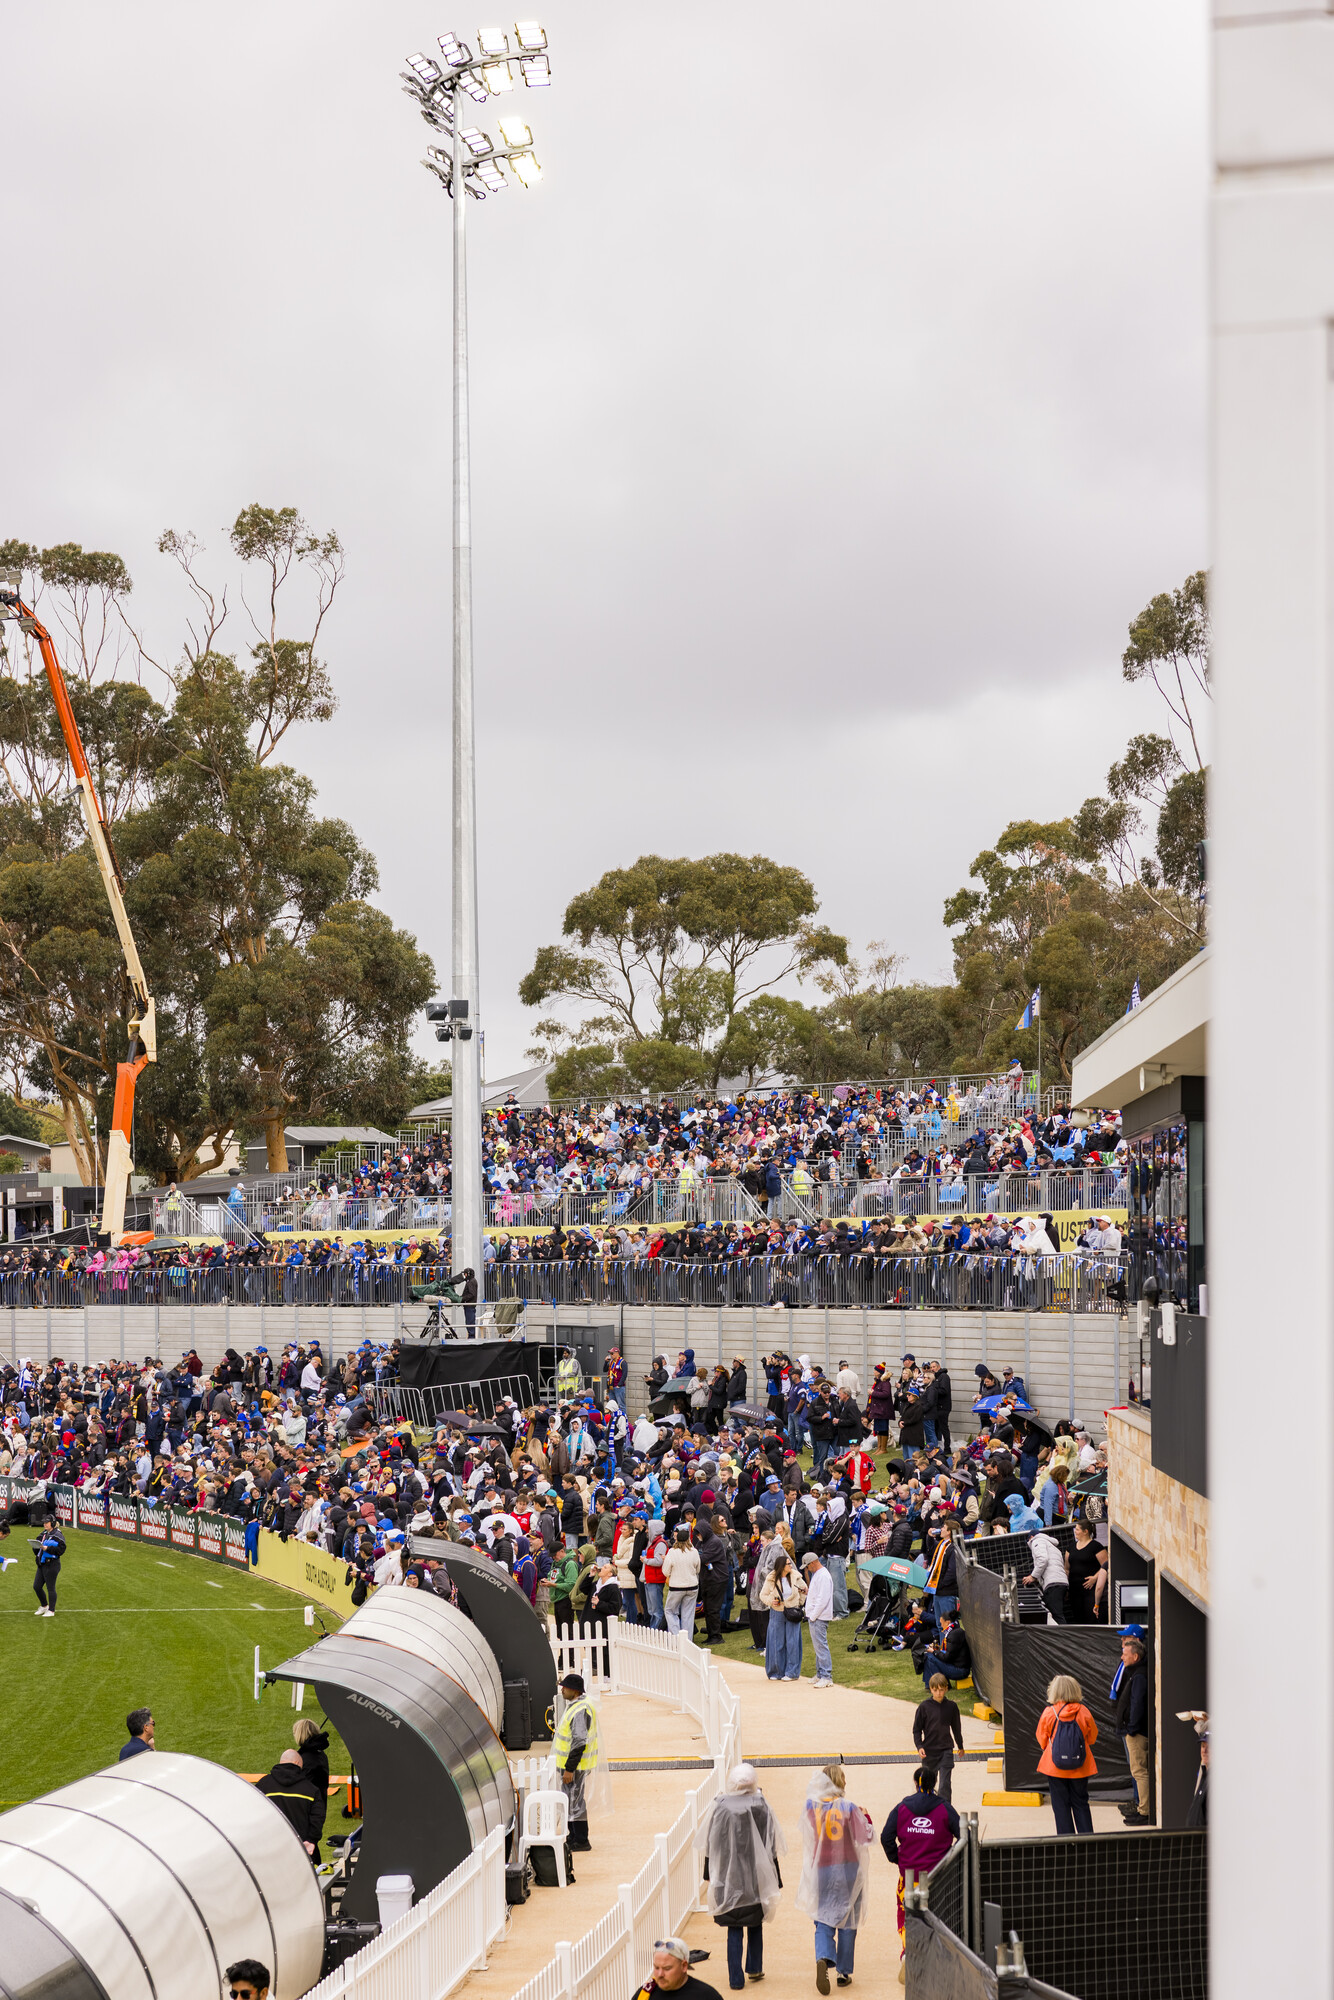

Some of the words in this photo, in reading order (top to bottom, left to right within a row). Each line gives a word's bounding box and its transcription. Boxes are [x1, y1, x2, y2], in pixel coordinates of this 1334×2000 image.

[80, 1511, 104, 1526] warehouse
[111, 1517, 135, 1533] warehouse
[141, 1523, 166, 1539] warehouse
[171, 1530, 194, 1546] warehouse
[224, 1522, 245, 1548] BUNNING
[199, 1537, 220, 1554] warehouse
[469, 1567, 507, 1593] AURORA
[346, 1693, 401, 1729] AURORA
[907, 1826, 935, 1835] HYUNDAI
